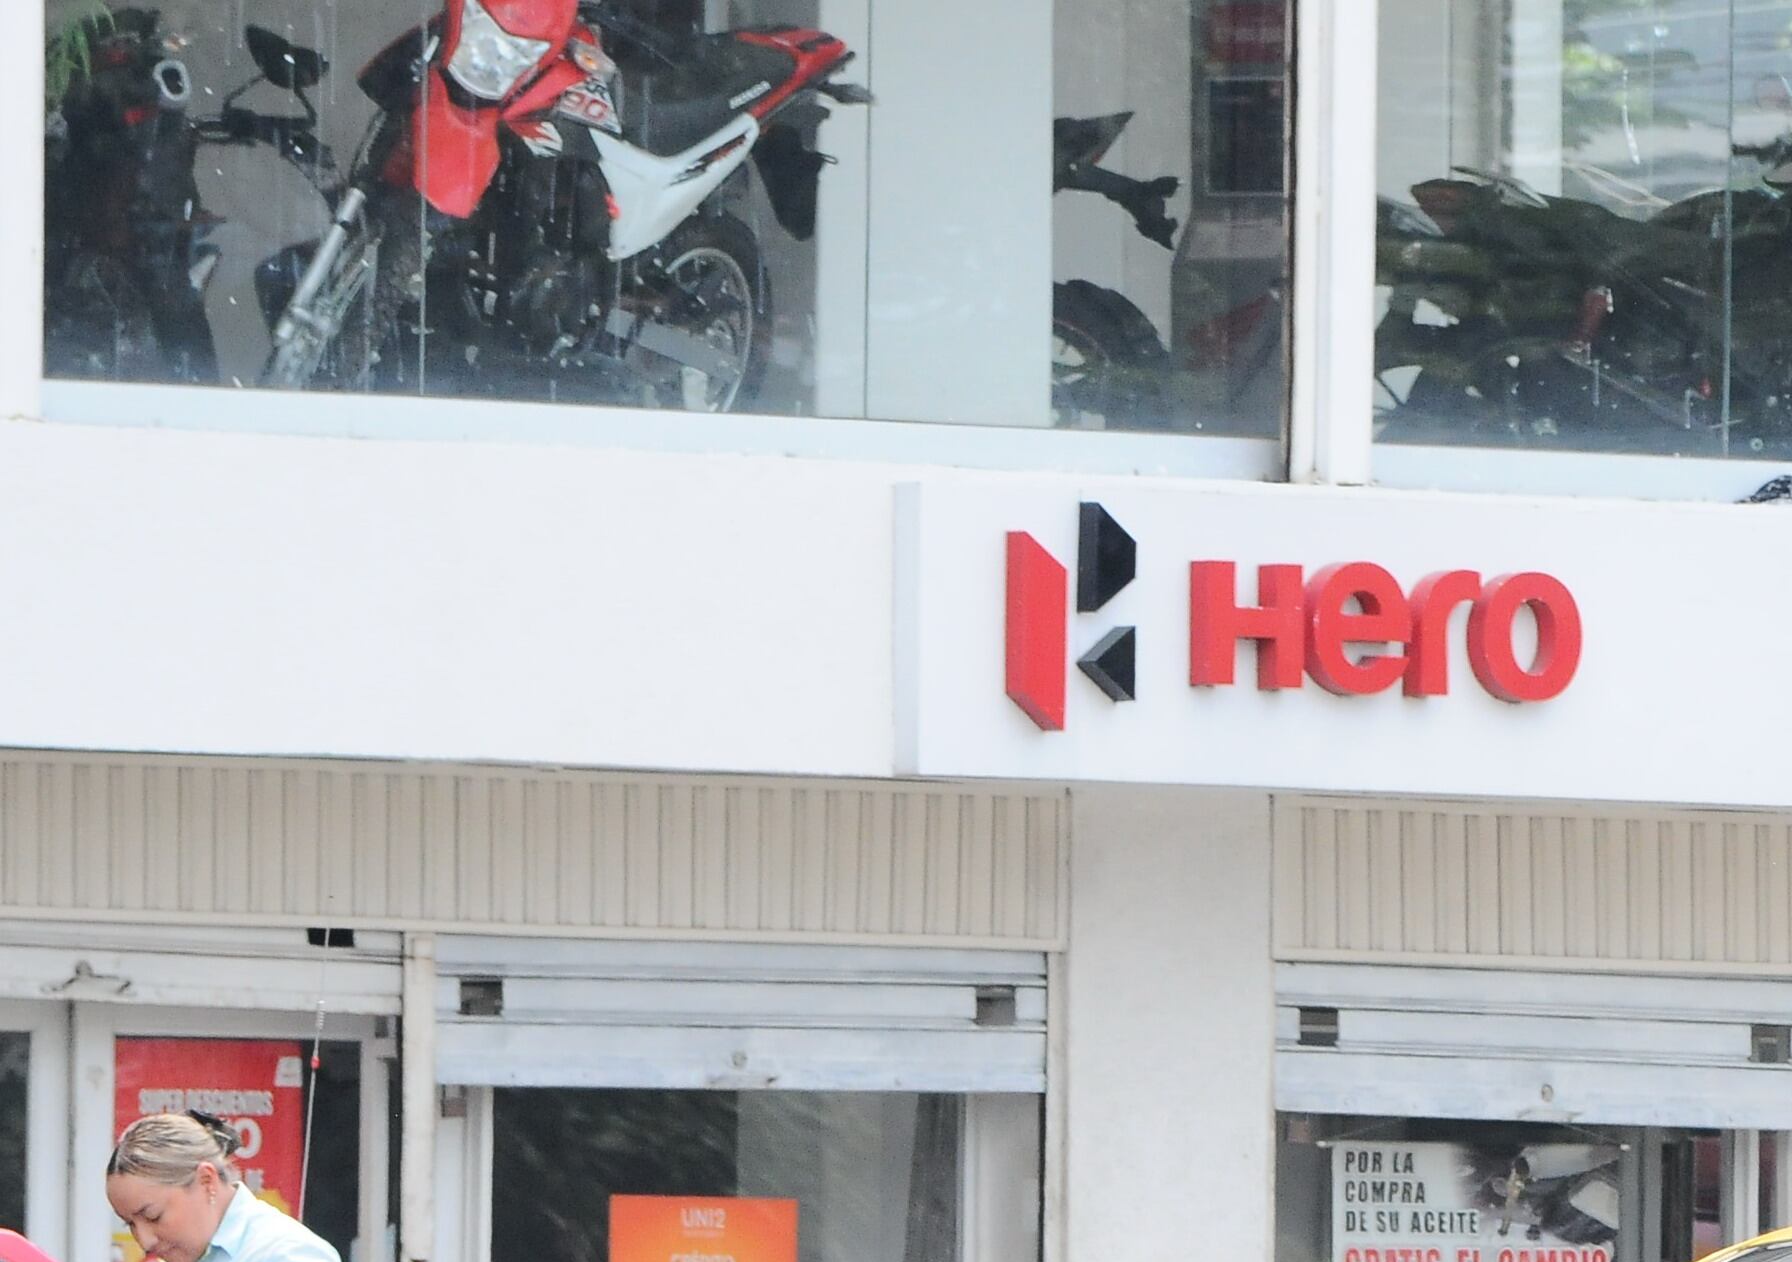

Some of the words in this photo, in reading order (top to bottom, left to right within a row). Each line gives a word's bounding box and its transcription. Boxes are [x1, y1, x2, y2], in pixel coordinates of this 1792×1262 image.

[1189, 560, 1582, 703] Hero
[1345, 1151, 1382, 1173] POR
[1393, 1152, 1414, 1174] LA
[1345, 1180, 1425, 1204] COMPRA
[1346, 1211, 1367, 1233] DE
[1377, 1211, 1400, 1233] SU
[1410, 1211, 1477, 1234] ACEITE
